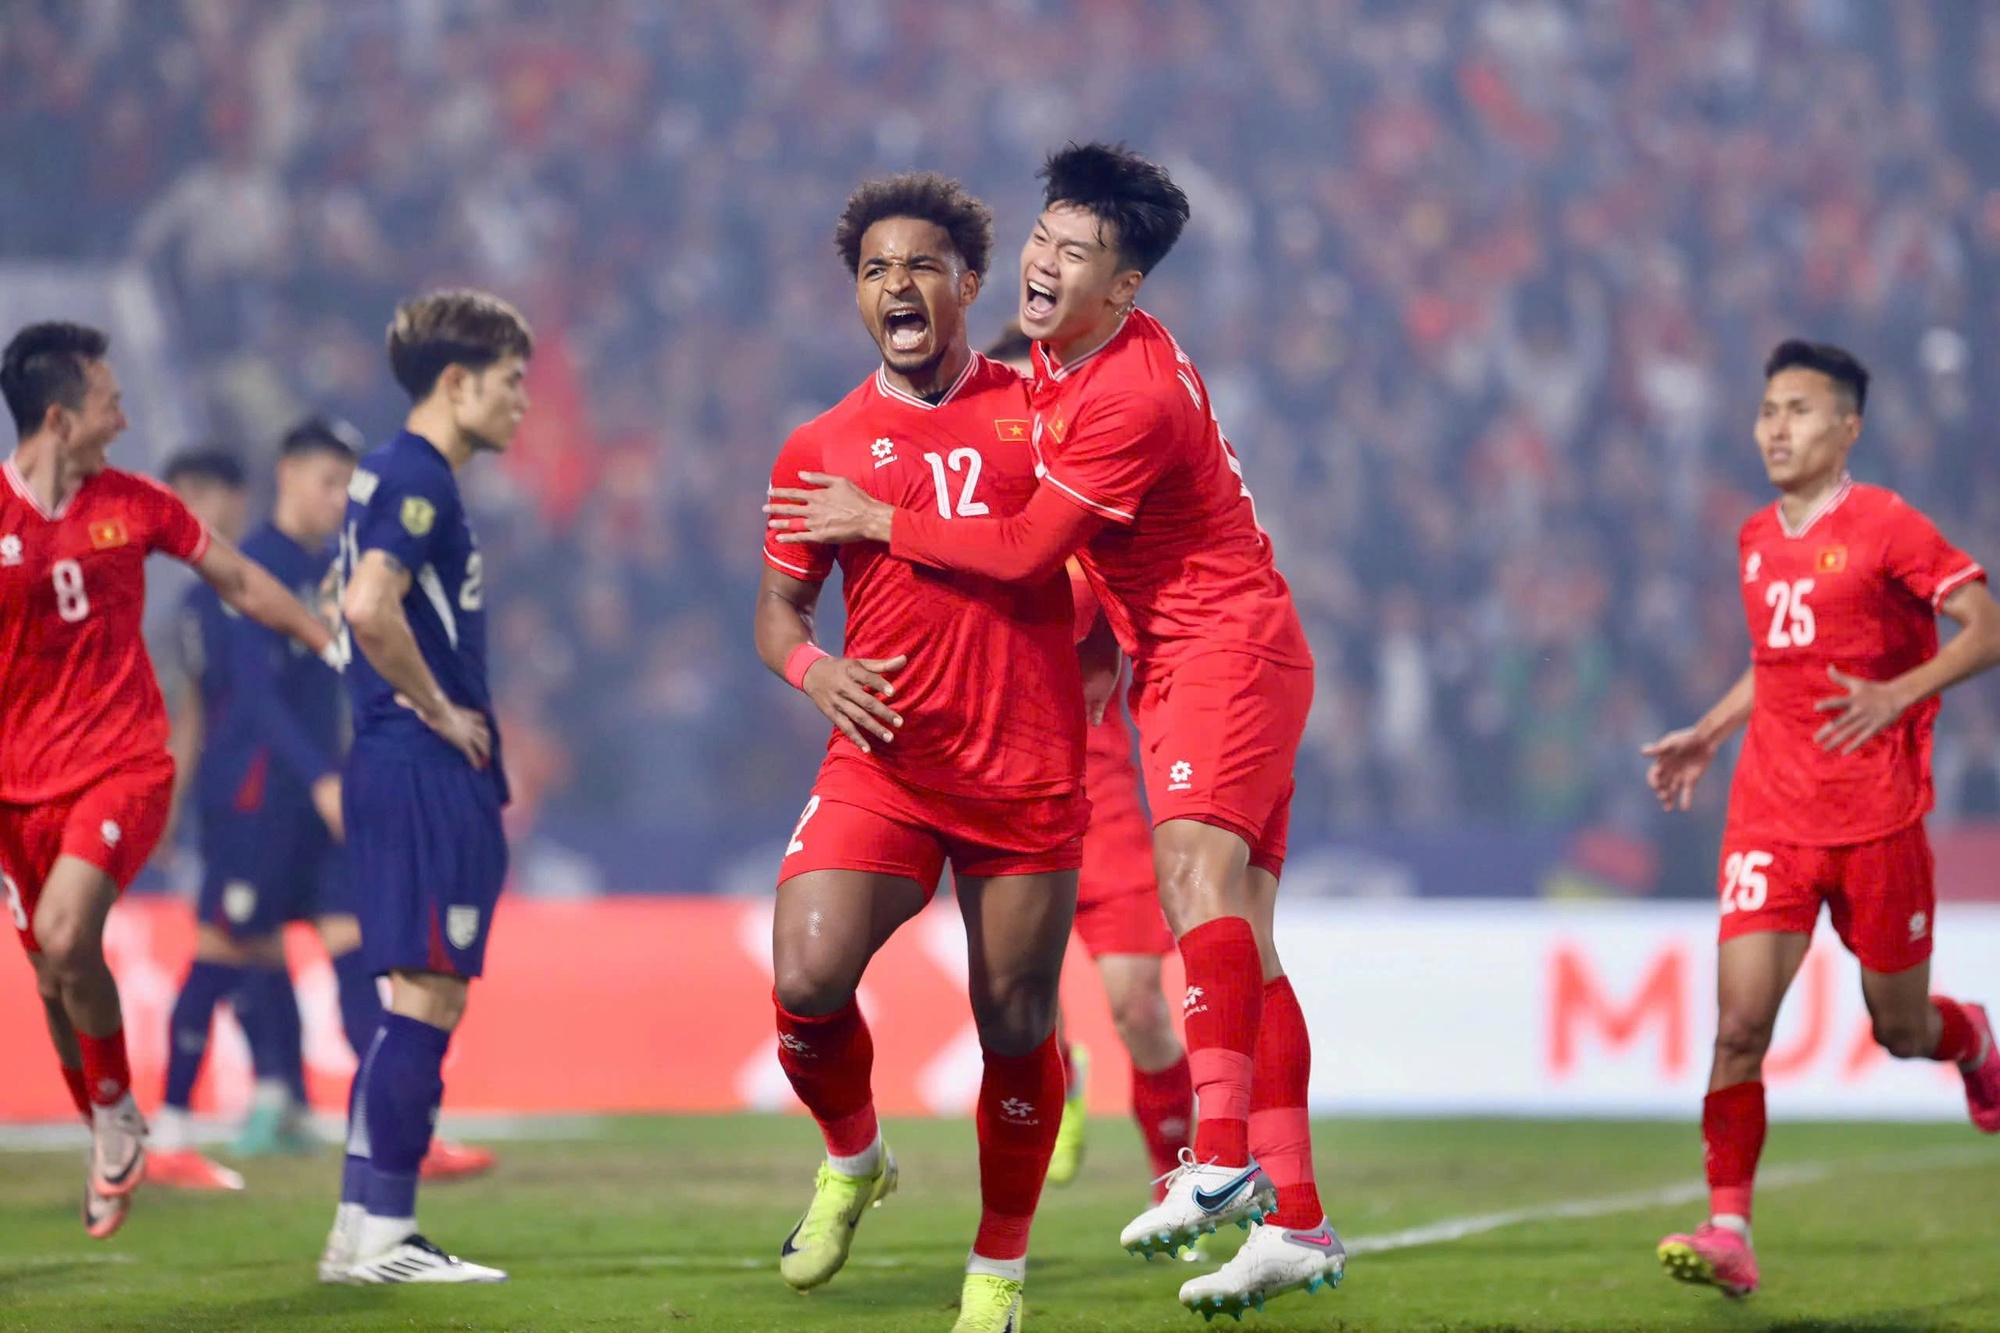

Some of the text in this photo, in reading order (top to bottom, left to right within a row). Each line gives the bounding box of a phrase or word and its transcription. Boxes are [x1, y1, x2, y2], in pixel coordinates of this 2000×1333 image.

[923, 447, 990, 520] 12
[52, 558, 90, 623] 8
[1765, 578, 1816, 649] 25
[1719, 850, 1774, 916] 25
